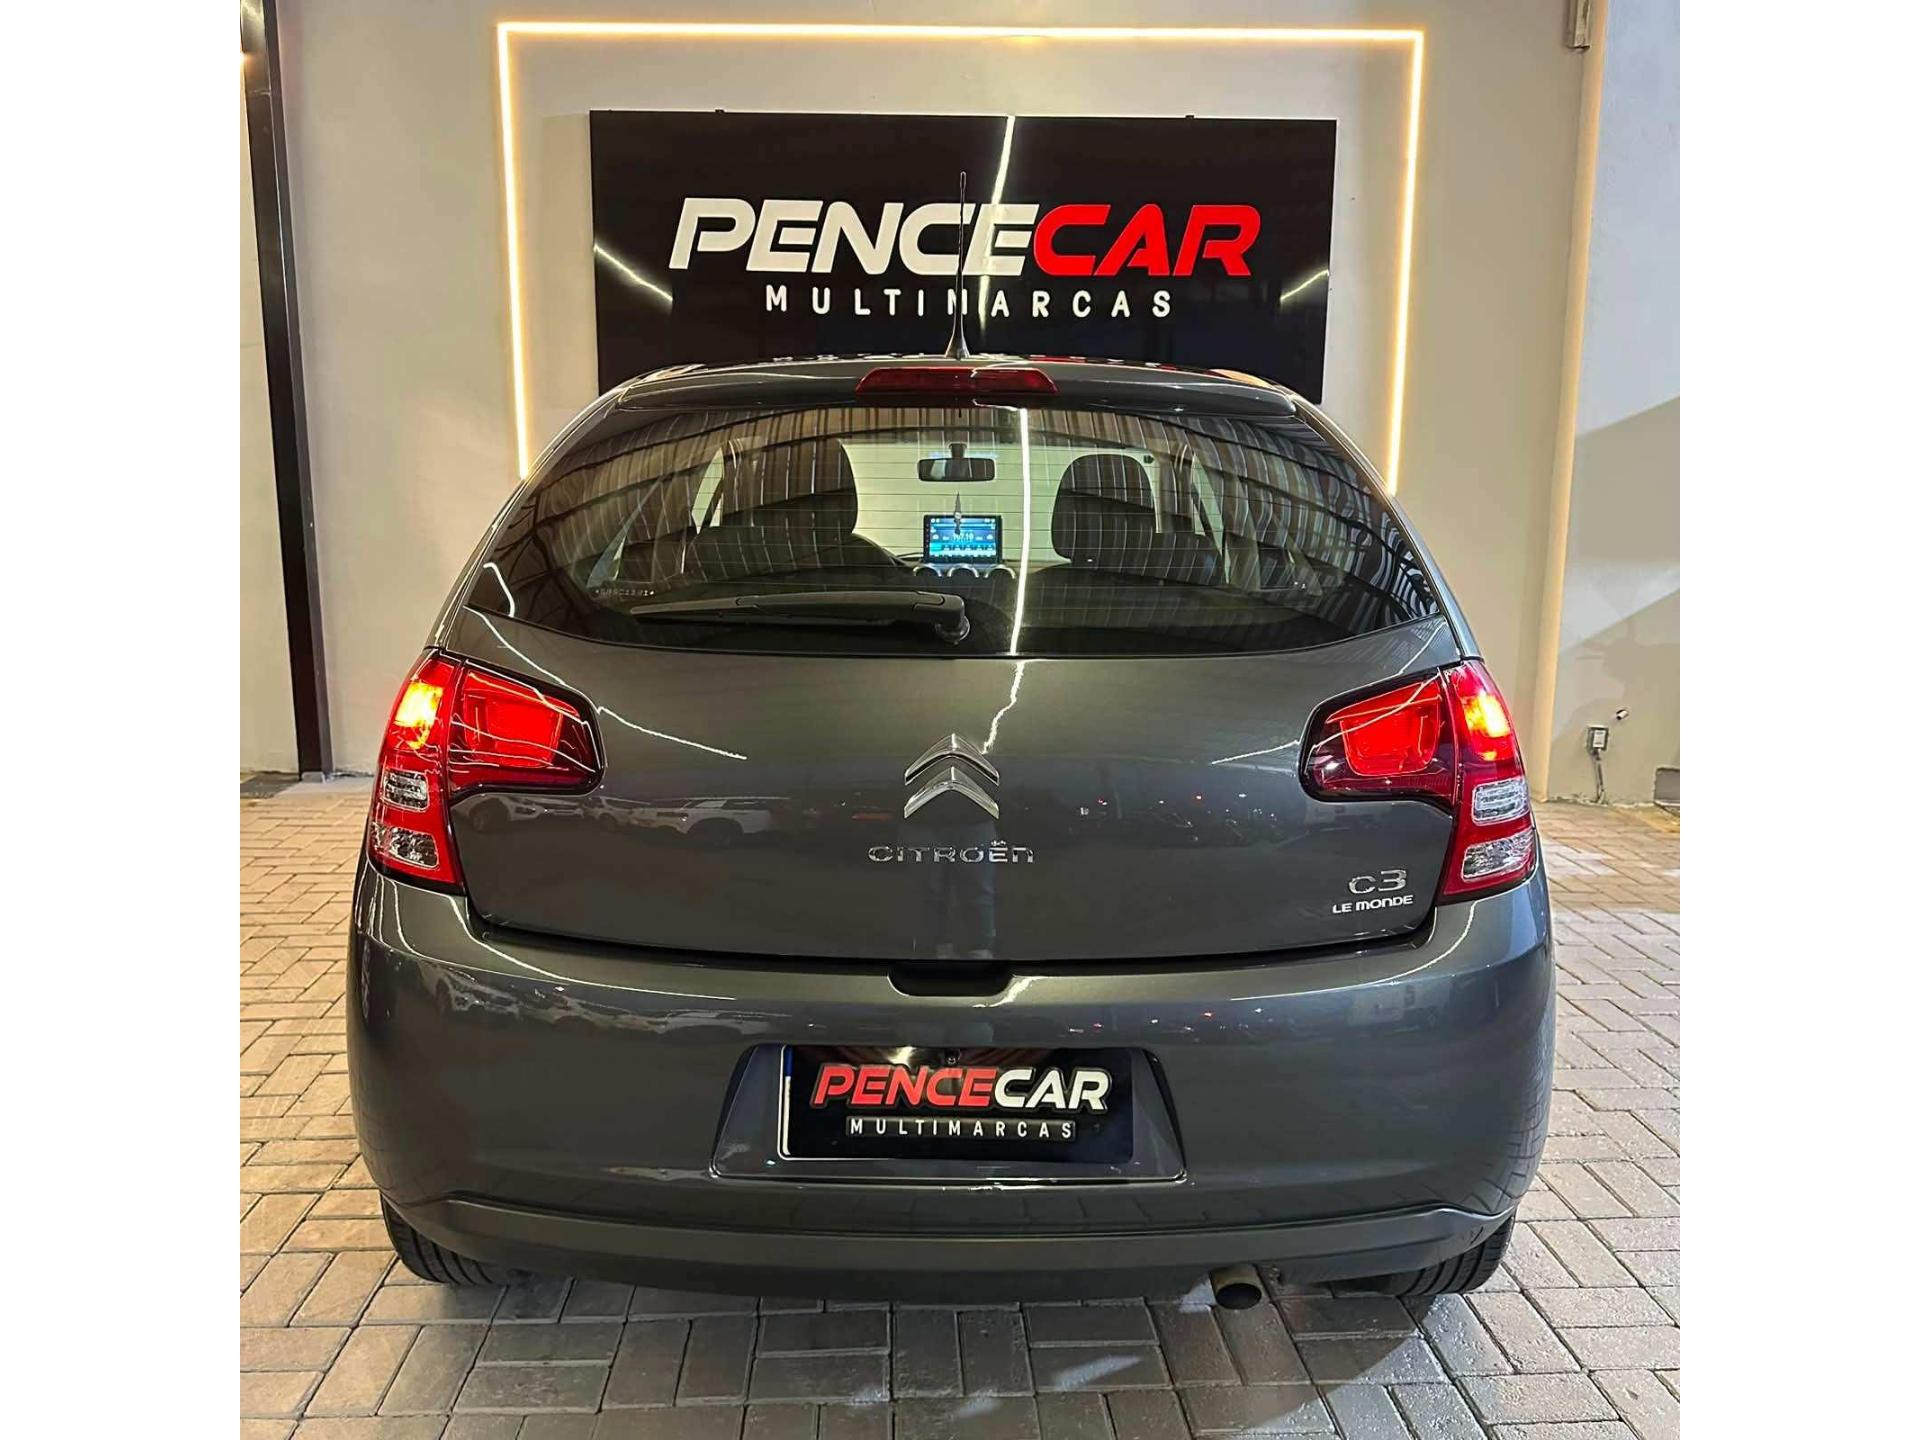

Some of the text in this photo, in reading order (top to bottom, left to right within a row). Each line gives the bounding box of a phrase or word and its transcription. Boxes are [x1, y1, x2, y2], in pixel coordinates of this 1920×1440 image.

[668, 197, 1260, 276] PENCECAR
[765, 285, 1171, 318] MULTIMARCAS
[1348, 869, 1407, 894] C3
[1332, 895, 1414, 914] LE MONDE
[813, 1065, 1109, 1111] PENCECAR
[850, 1117, 1073, 1139] MULTIMARCAS
